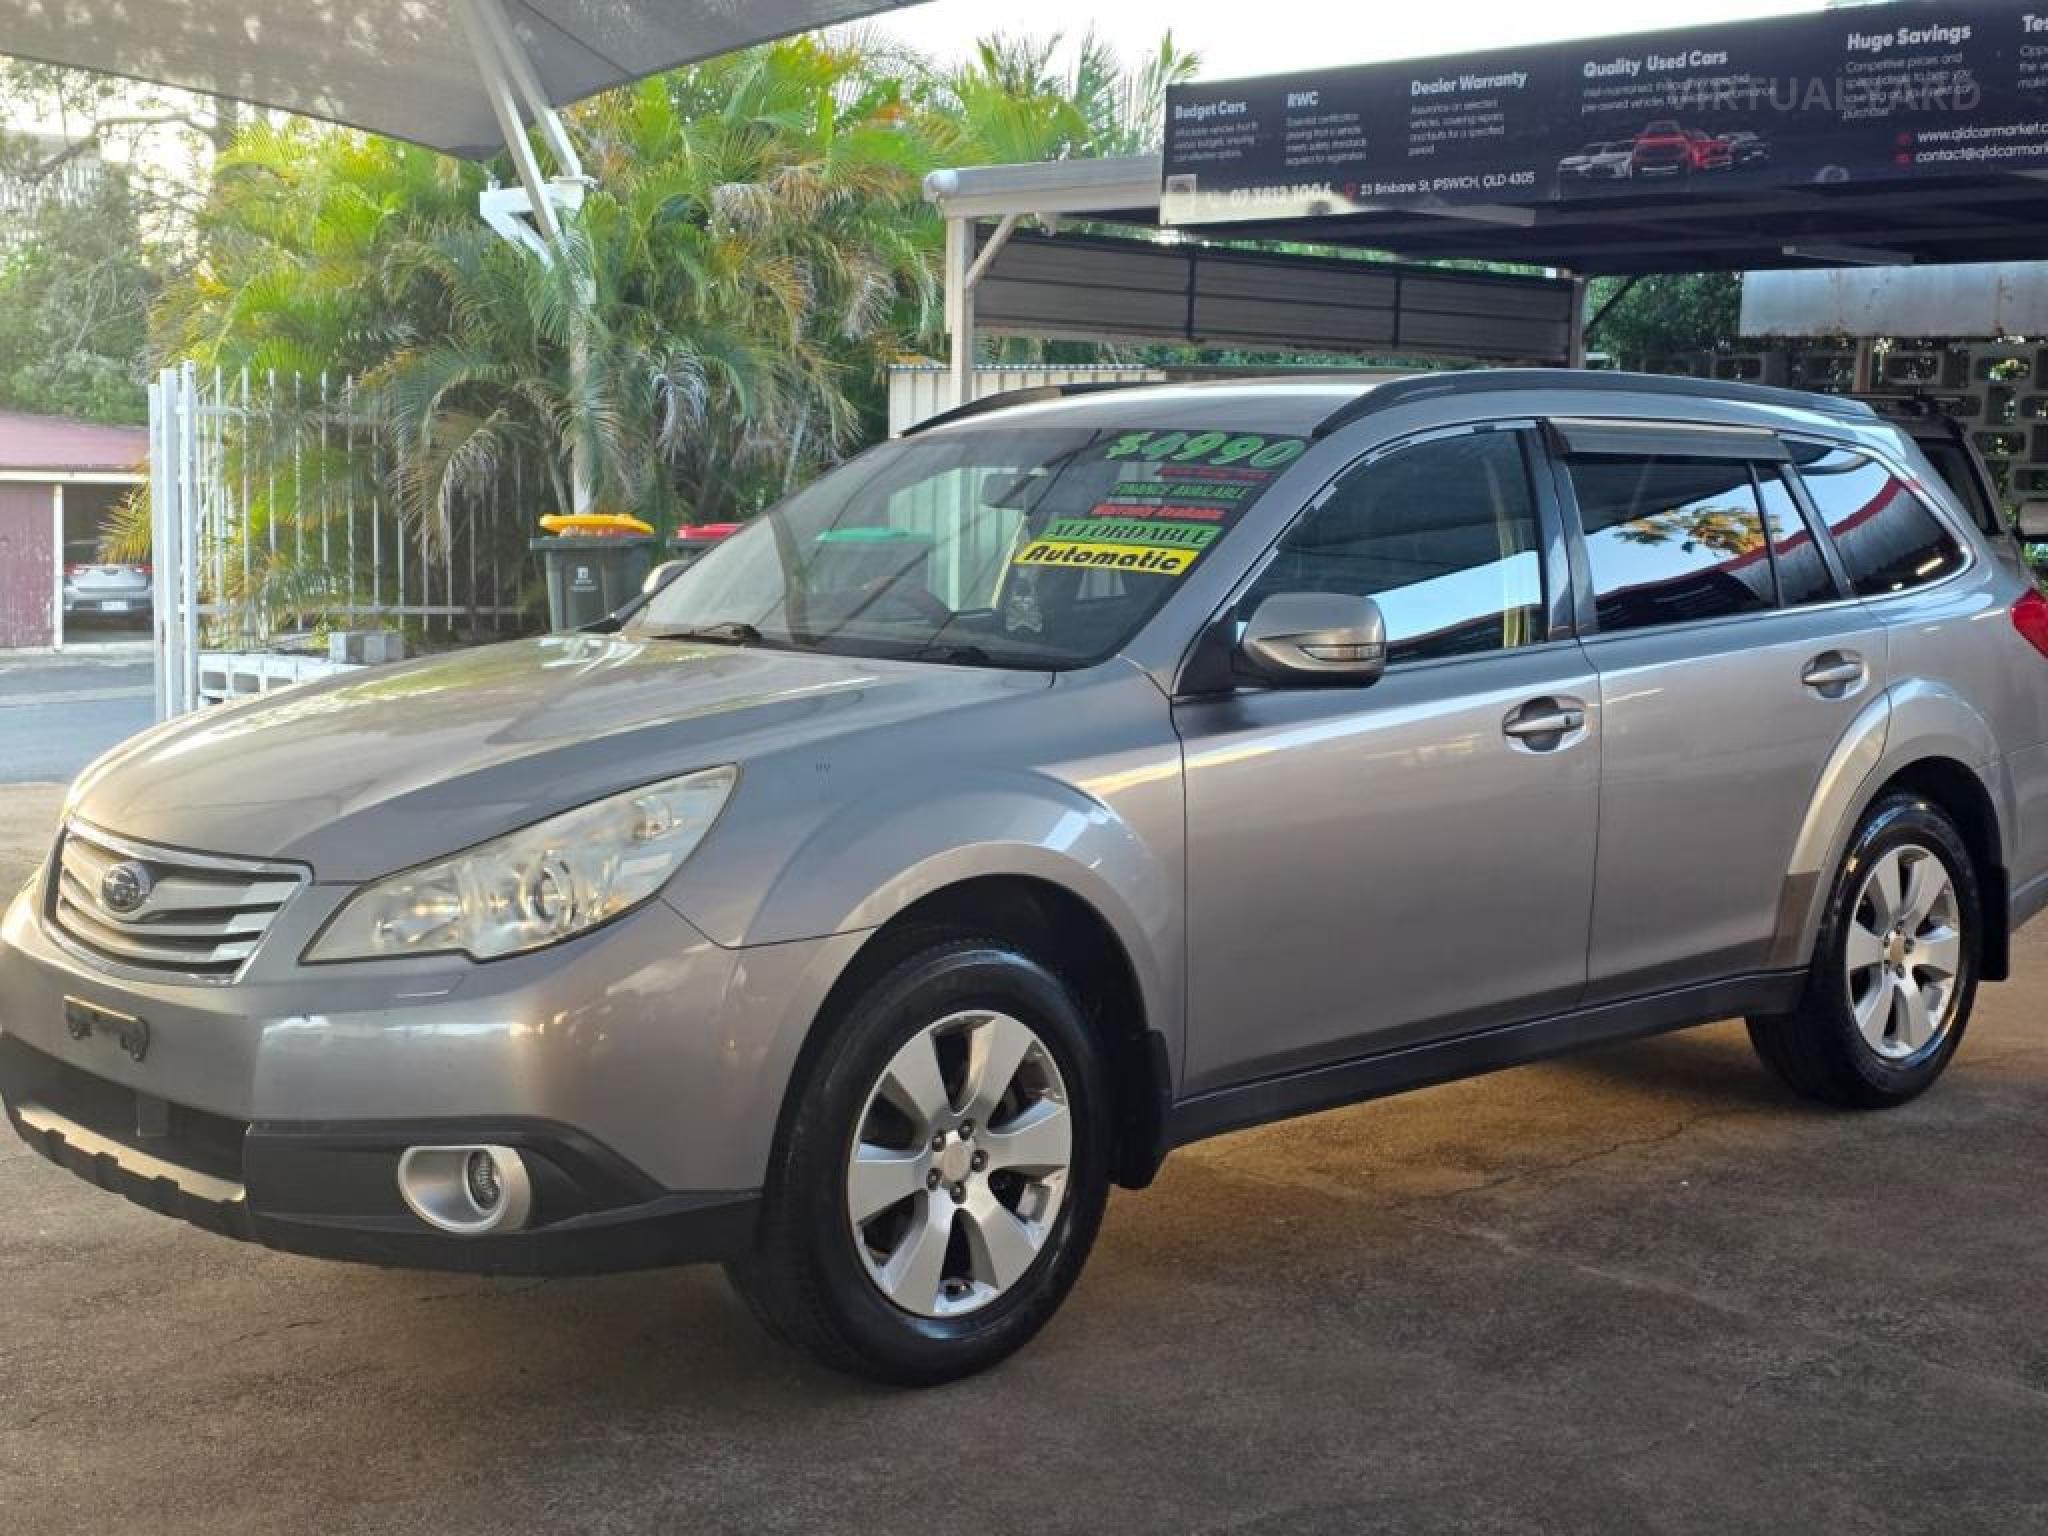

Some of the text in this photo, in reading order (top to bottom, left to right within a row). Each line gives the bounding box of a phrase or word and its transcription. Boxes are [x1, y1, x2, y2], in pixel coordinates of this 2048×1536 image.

[1847, 24, 1972, 53] Huge Savings
[1584, 50, 1728, 77] Quality Used Cars
[1411, 71, 1528, 97] Dealer Warranty
[1175, 99, 1247, 121] Budget Cars
[1287, 90, 1319, 108] RWC
[1375, 181, 1417, 195] Brisbane
[1483, 173, 1507, 189] QLD
[1023, 544, 1181, 571] Automatic
